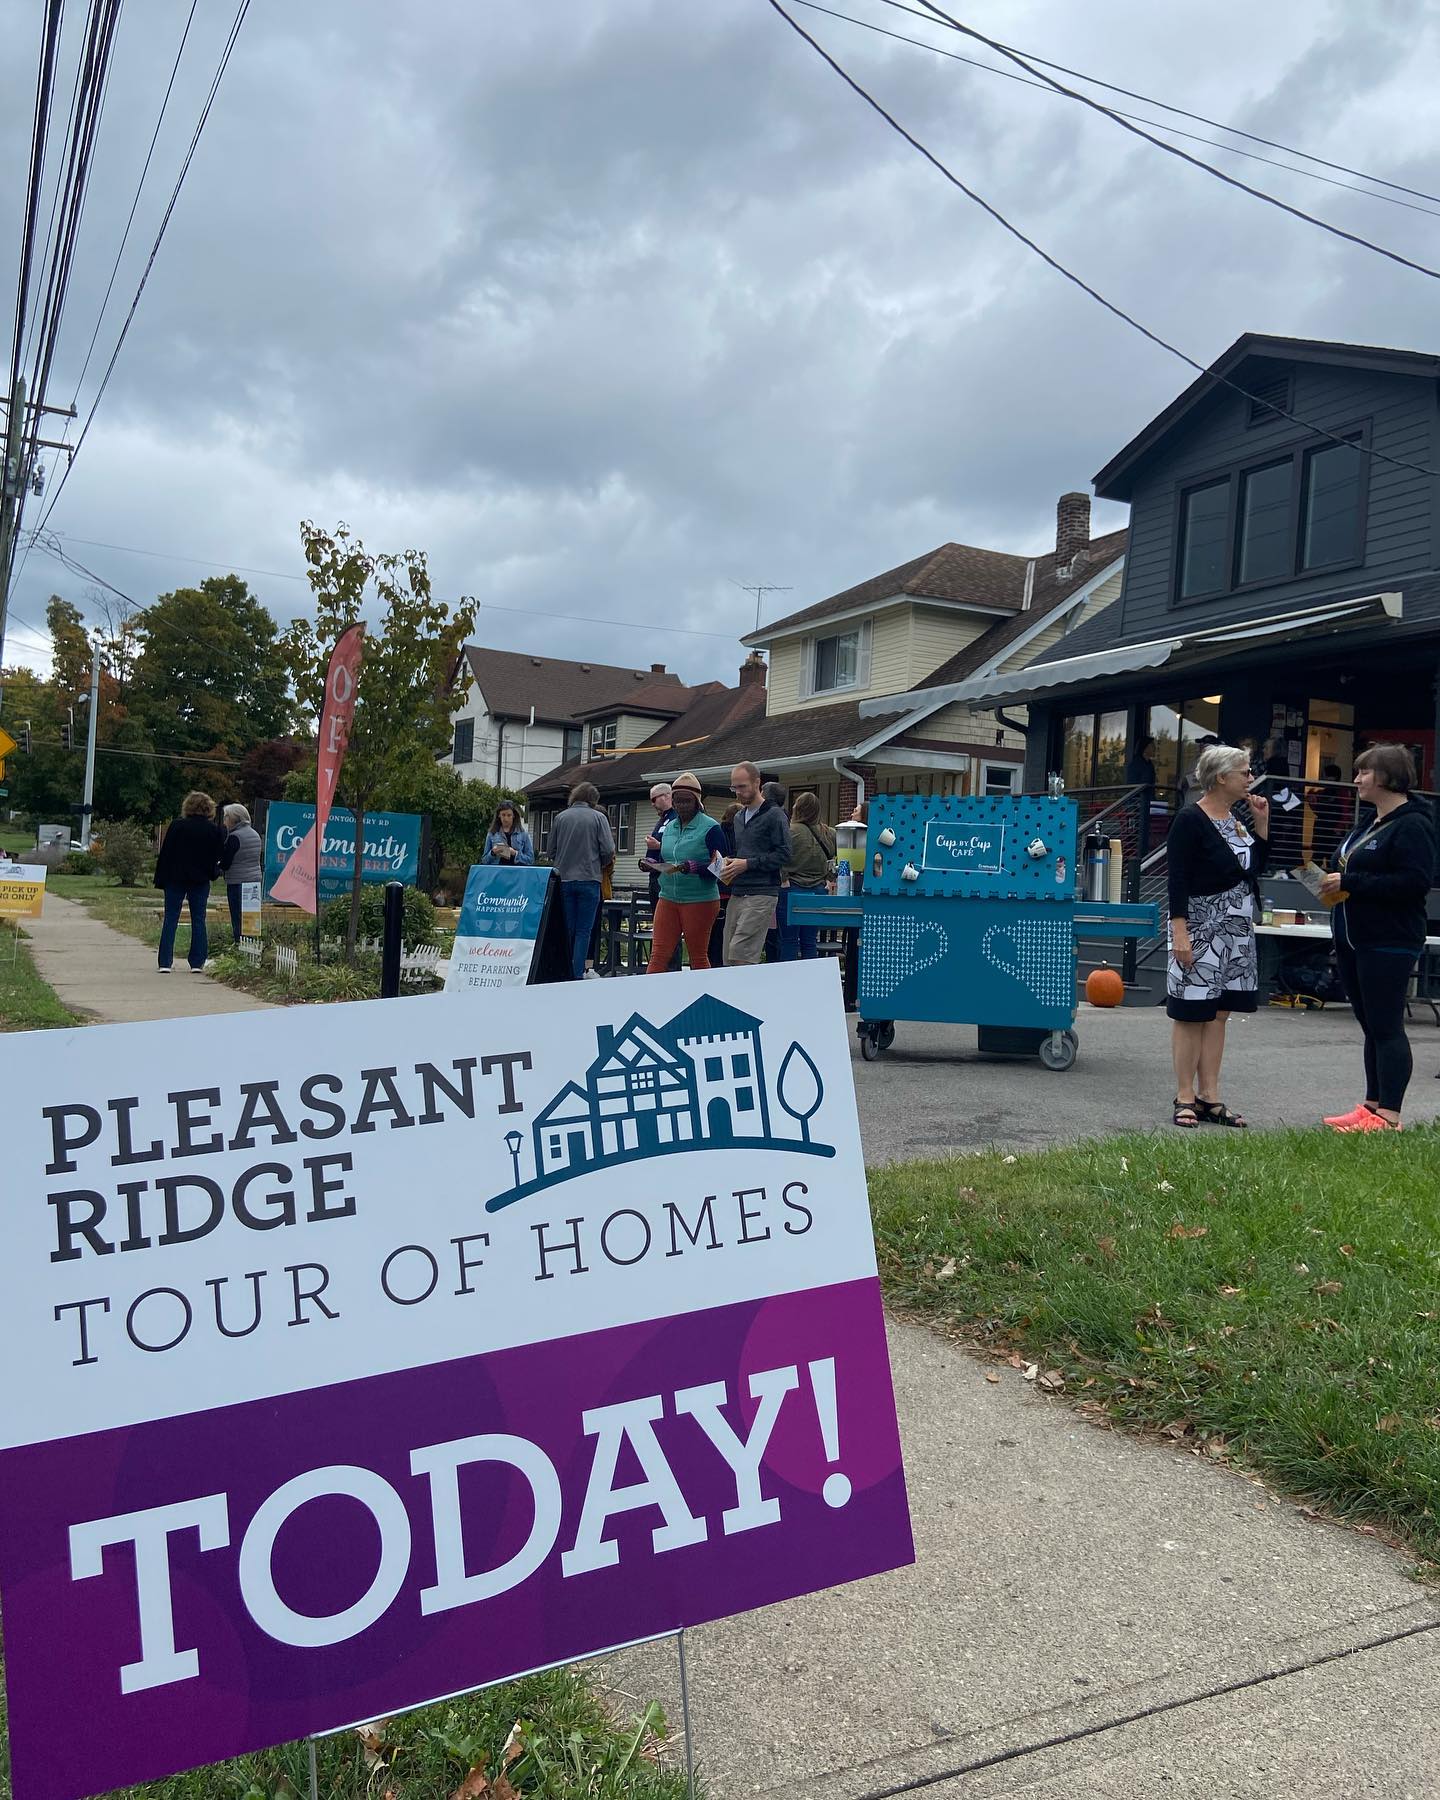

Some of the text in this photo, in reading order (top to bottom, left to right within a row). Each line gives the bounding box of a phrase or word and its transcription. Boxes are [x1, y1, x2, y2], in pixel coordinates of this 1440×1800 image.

[328, 816, 375, 825] ONTGORY
[936, 834, 957, 851] Cup
[970, 836, 992, 853] Cup
[952, 848, 975, 858] CAFÉ
[276, 853, 390, 872] HENS ERE
[477, 892, 529, 912] Community
[469, 942, 513, 958] welcome
[458, 963, 521, 975] FREE PARKING
[468, 977, 502, 988] BEHIND
[42, 1051, 533, 1176] PLEASANT
[47, 1152, 357, 1263] RIDGE
[54, 1181, 814, 1366] TOUR OF HOMES
[68, 1357, 853, 1695] TODAY!
